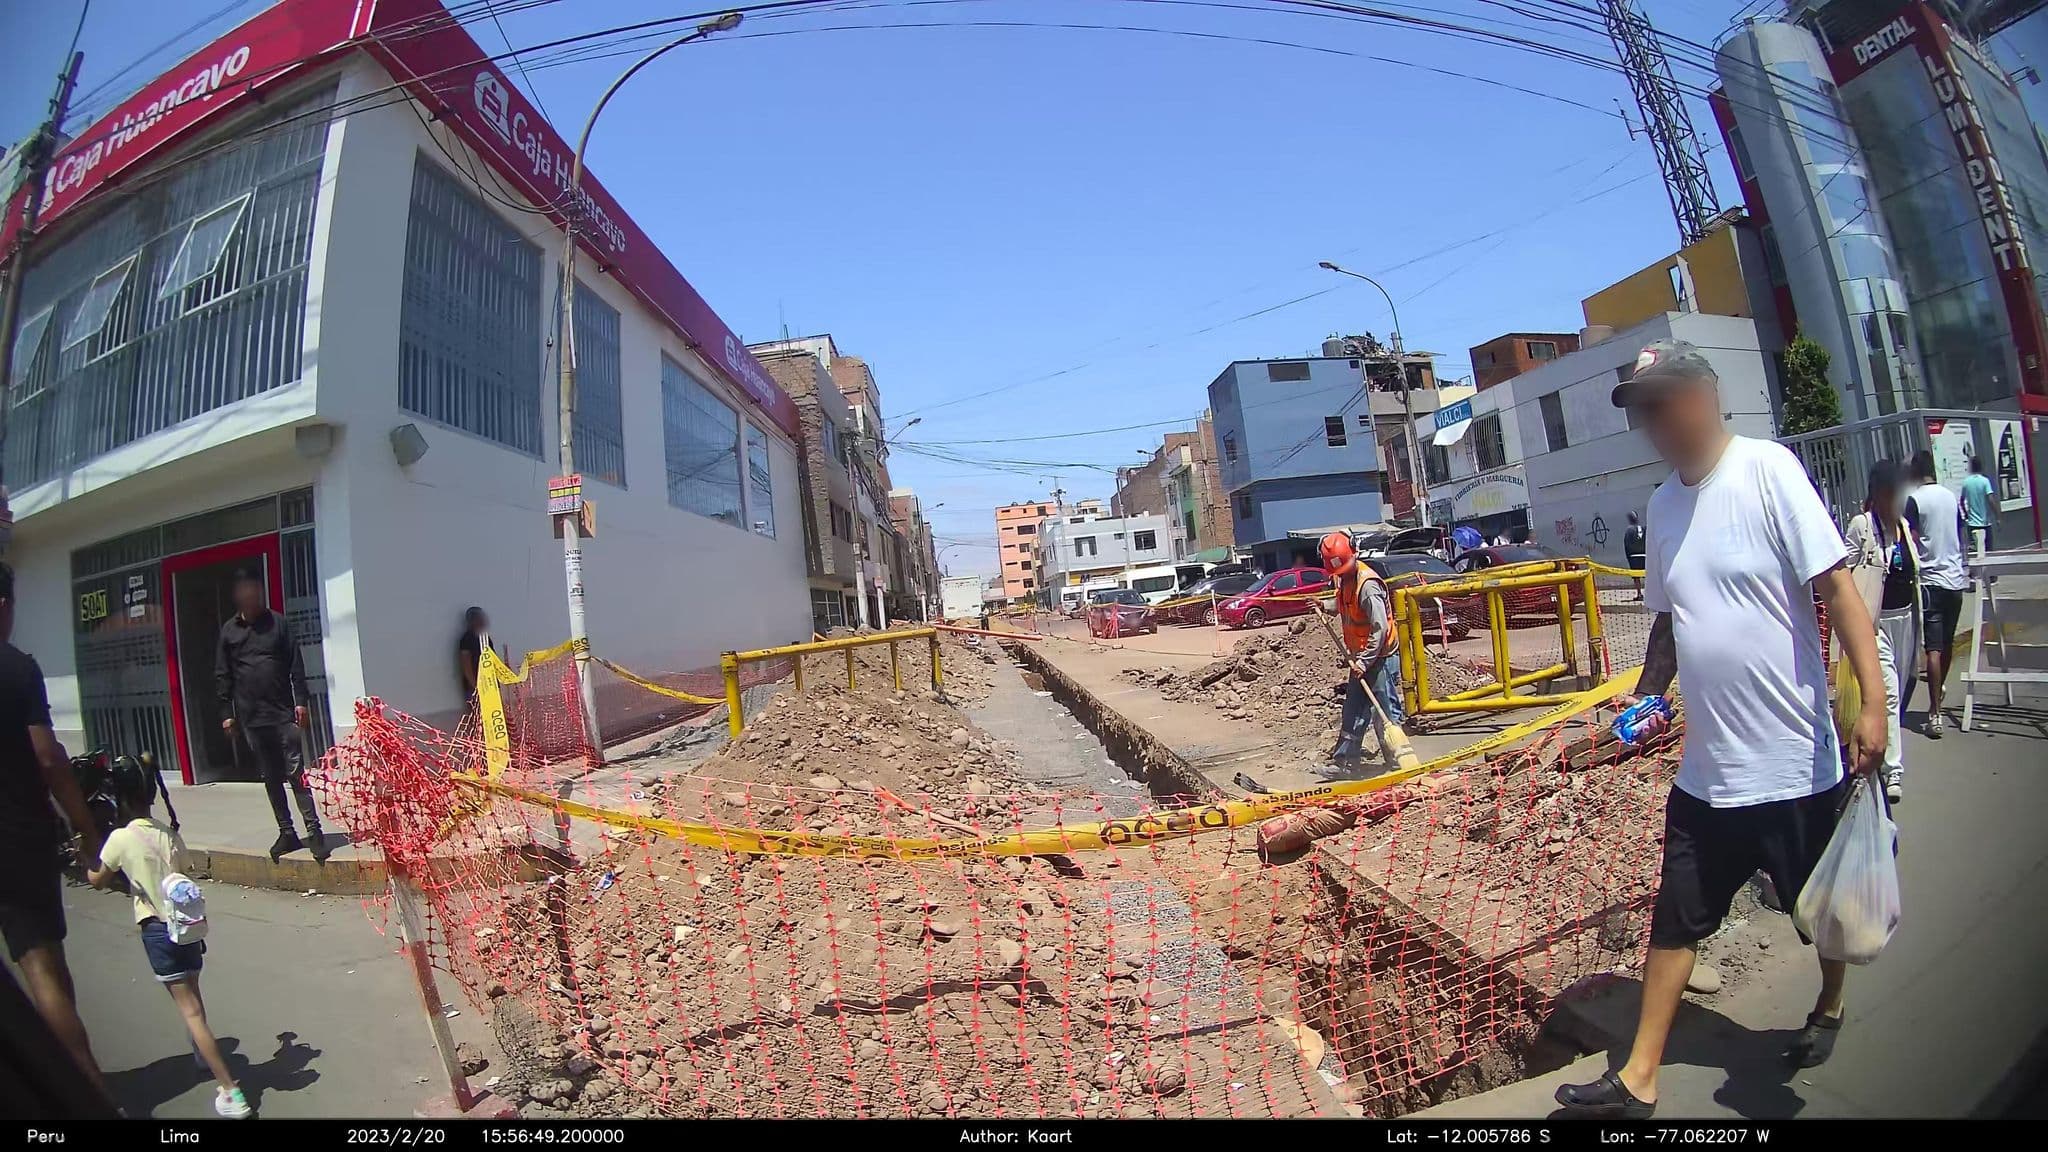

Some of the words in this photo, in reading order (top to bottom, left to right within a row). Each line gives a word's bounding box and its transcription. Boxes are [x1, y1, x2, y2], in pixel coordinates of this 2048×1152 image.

[1853, 16, 1916, 65] DENTAL
[56, 141, 104, 193] Caja
[105, 45, 251, 158] Huancayo
[512, 111, 552, 178] Caja
[1924, 54, 2011, 271] LUMIDENT
[1436, 406, 1463, 428] VIALCI
[81, 590, 107, 621] SOAT
